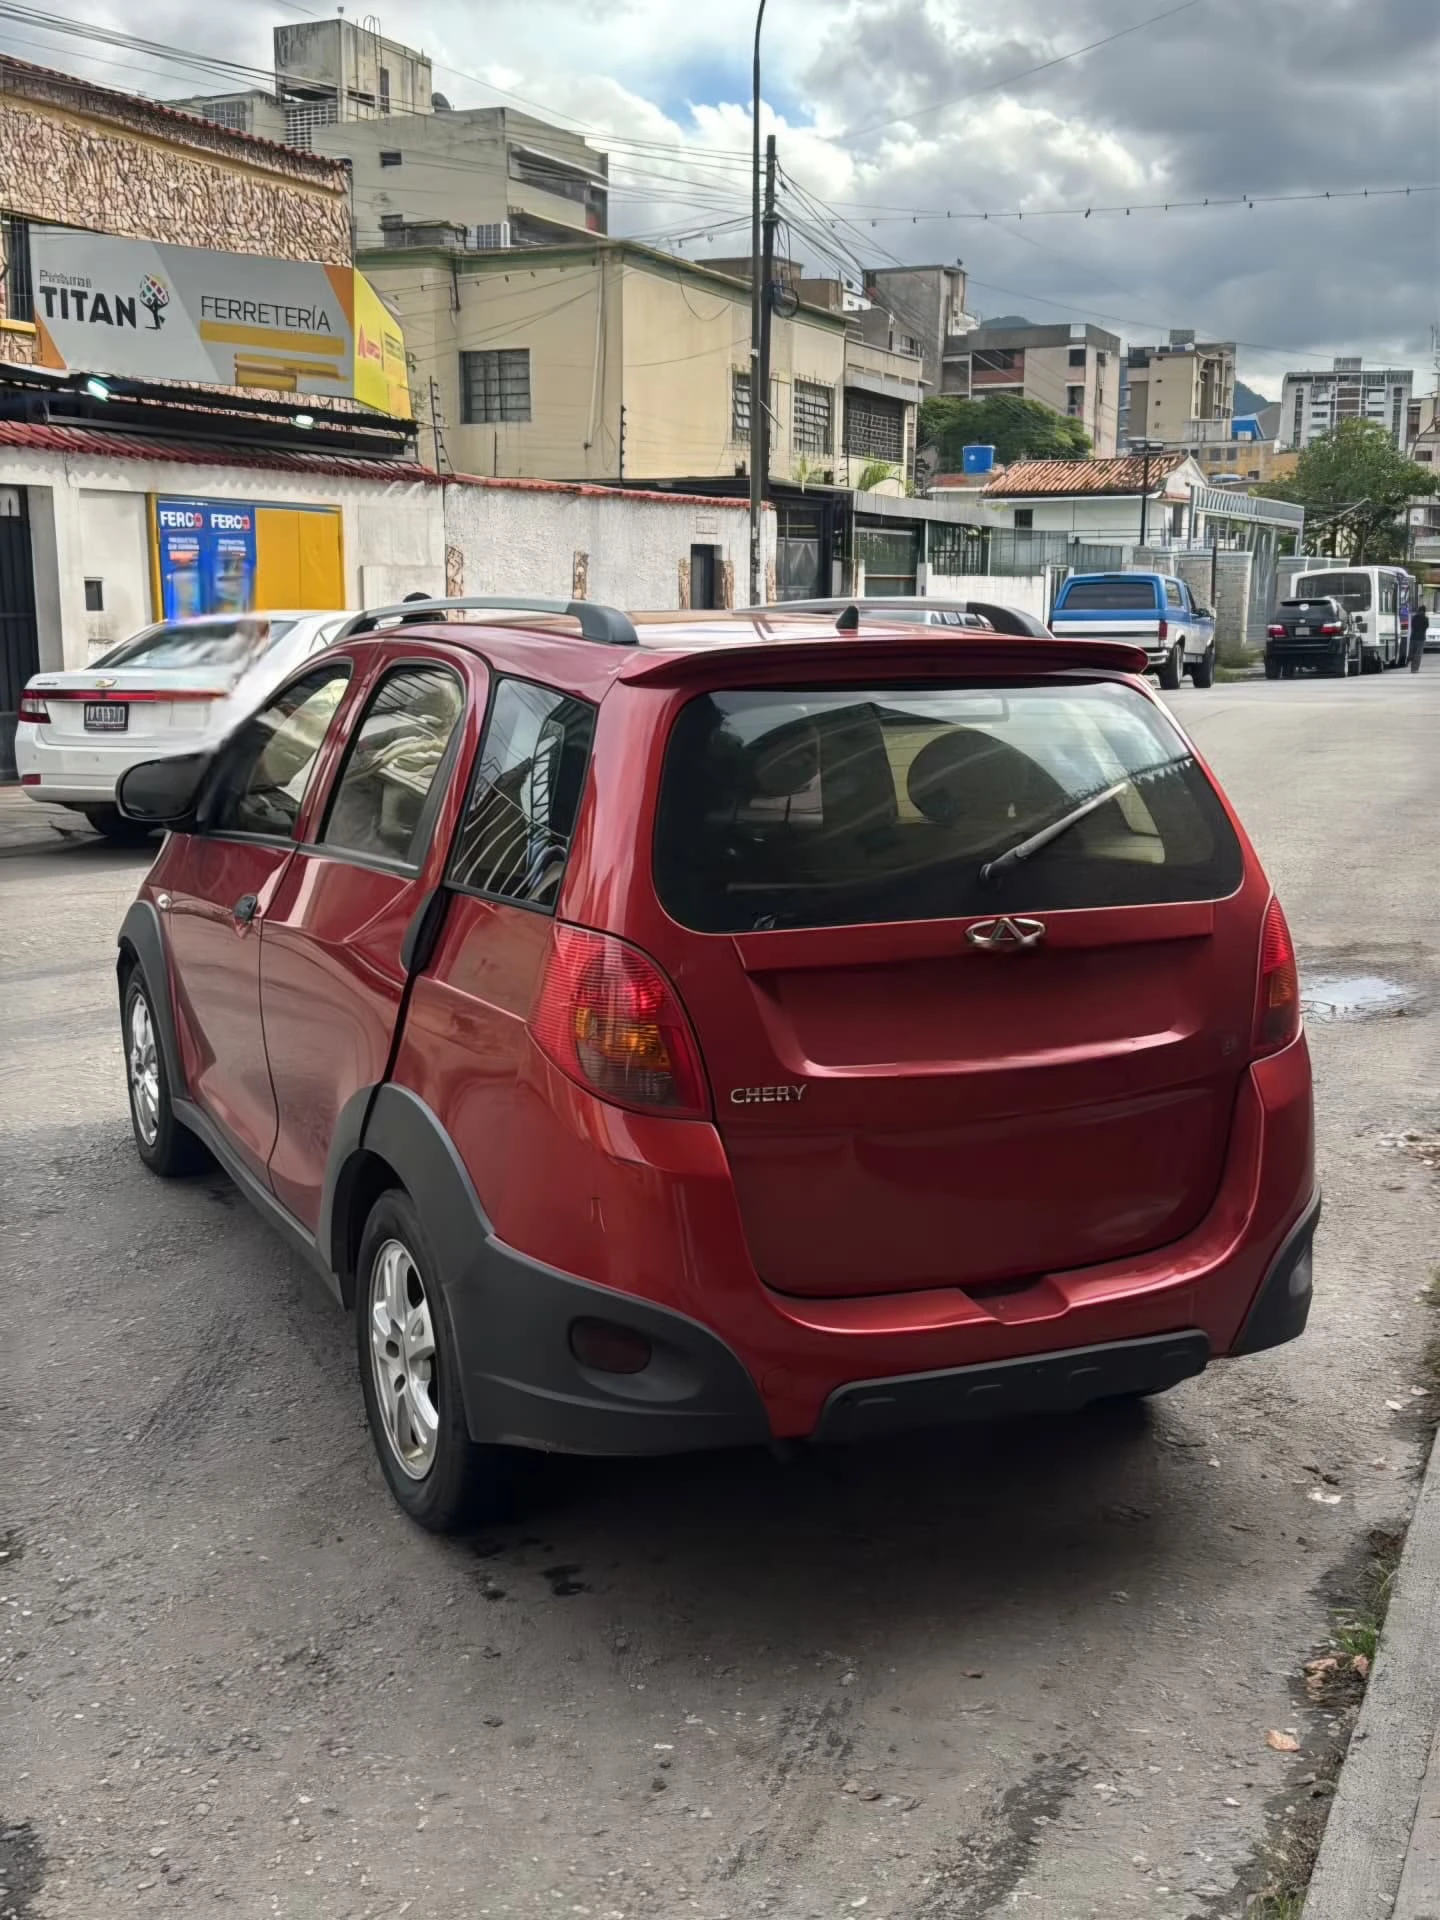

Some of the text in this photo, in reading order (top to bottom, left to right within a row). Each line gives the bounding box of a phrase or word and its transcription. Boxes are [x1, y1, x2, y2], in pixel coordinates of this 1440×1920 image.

[39, 285, 137, 329] TITAN
[201, 295, 331, 333] FERRETERÍA
[730, 1084, 807, 1103] CHERY
